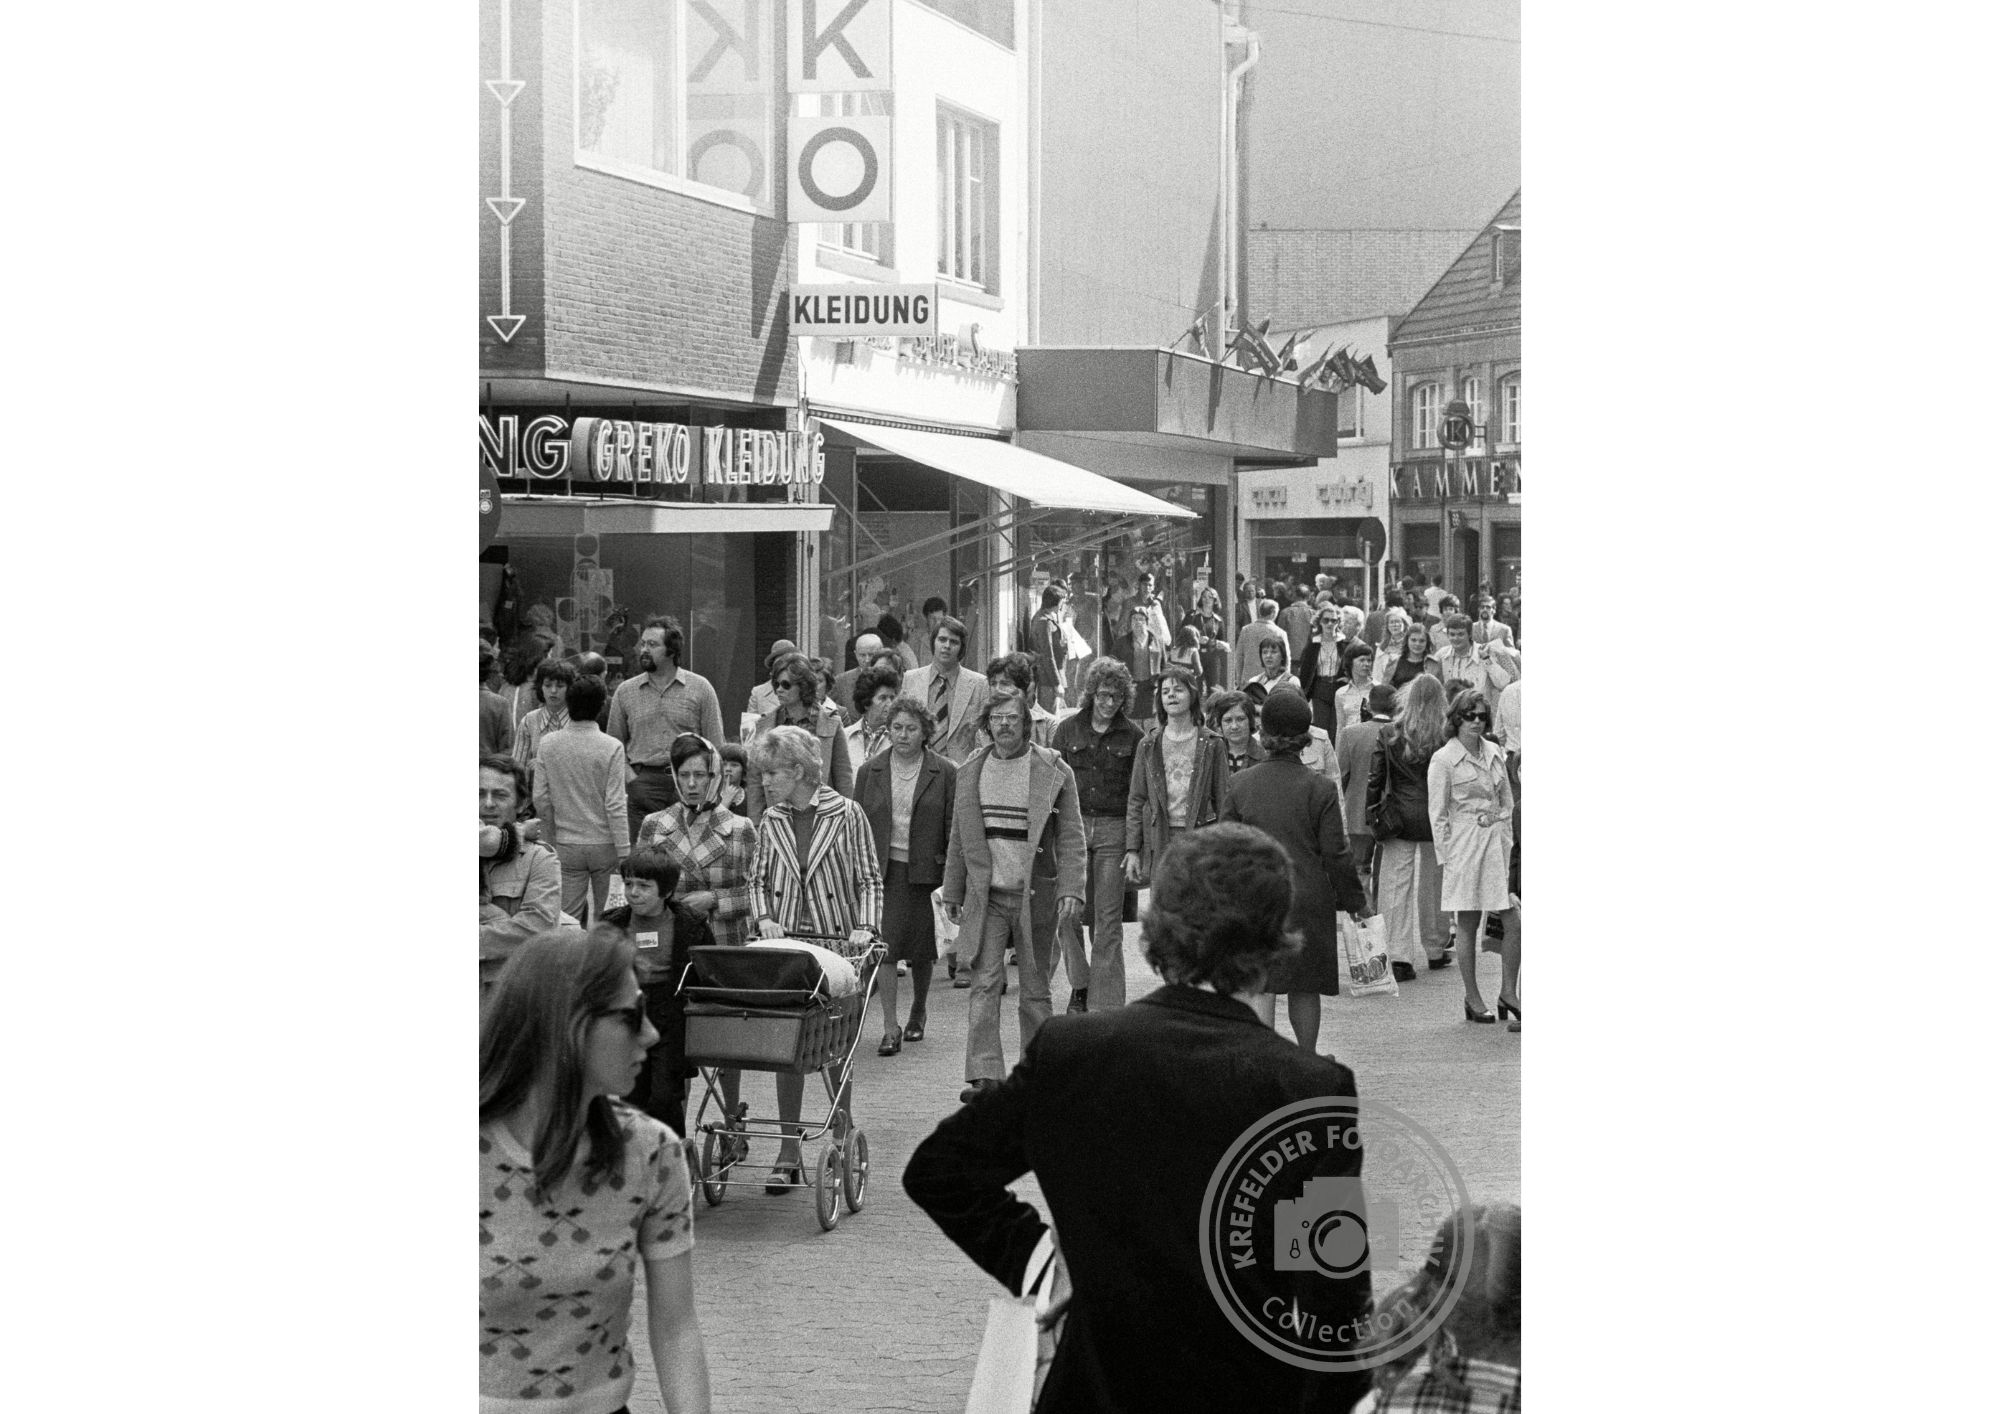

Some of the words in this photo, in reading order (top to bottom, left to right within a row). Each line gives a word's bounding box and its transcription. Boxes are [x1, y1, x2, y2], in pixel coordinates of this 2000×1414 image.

[794, 295, 929, 324] KLEIDUNG
[596, 419, 691, 482] GREKO
[702, 425, 826, 486] KLEIDUNG
